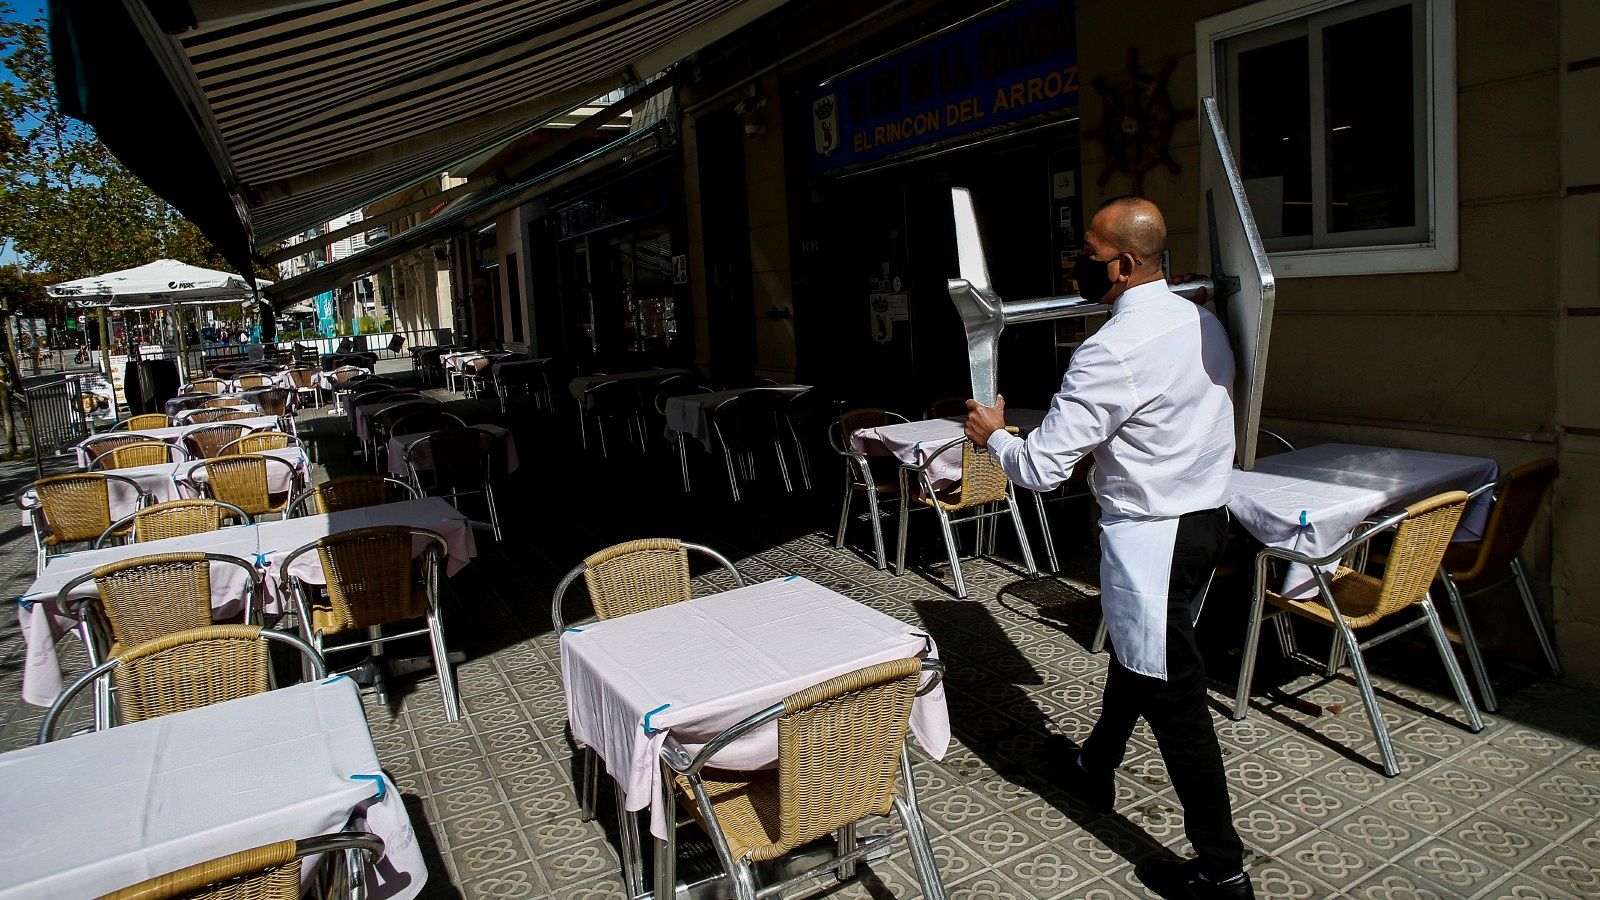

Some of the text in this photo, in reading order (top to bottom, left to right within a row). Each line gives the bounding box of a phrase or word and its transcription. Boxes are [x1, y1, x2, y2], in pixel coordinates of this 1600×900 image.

[853, 66, 1079, 153] EL RINCON DEL ARROZ
